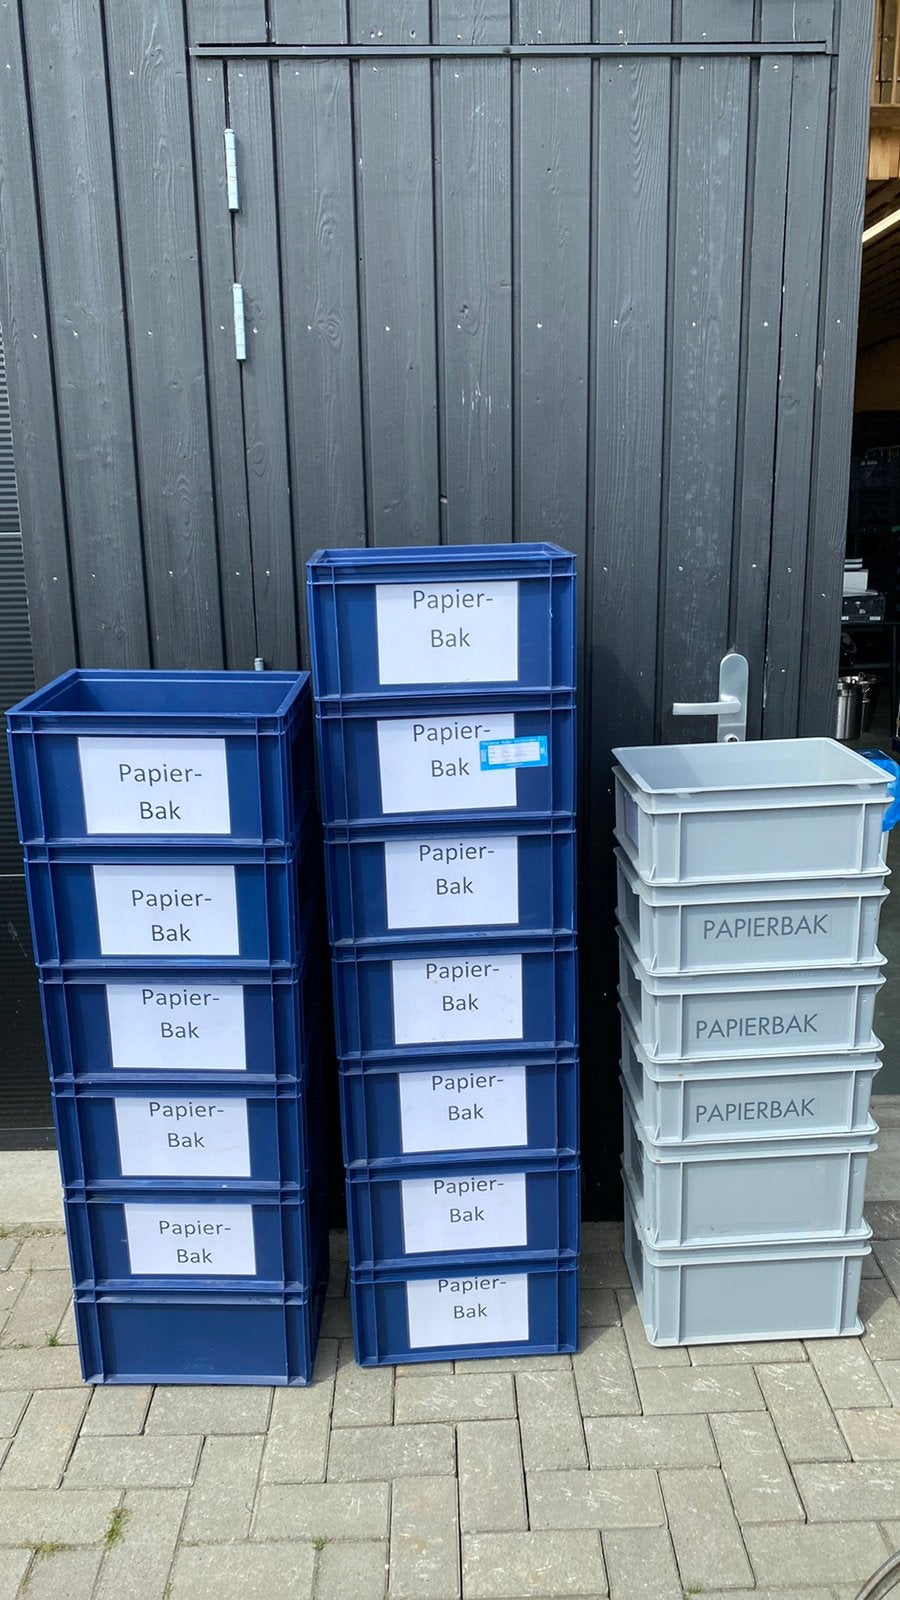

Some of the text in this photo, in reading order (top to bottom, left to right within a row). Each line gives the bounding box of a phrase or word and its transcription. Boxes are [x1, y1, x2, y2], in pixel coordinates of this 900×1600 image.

[413, 588, 494, 613] Papier-
[431, 627, 471, 648] Bak
[412, 721, 491, 745] Papier-
[119, 763, 203, 787] Papier-
[431, 757, 470, 778] Bak
[139, 800, 181, 820] Bak
[418, 842, 495, 865] Papier-
[436, 876, 474, 895] Bak
[131, 889, 212, 911] Papier-
[151, 923, 192, 942] Bak
[703, 914, 829, 940] PAPIERBAK
[426, 961, 500, 983] Papier-
[141, 988, 220, 1010] Papier-
[442, 993, 479, 1012] Bak
[160, 1021, 200, 1039] Bak
[696, 1013, 818, 1040] PAPIERBAK
[431, 1073, 504, 1093] Papier-
[149, 1101, 224, 1121] Papier-
[448, 1103, 484, 1121] Bak
[696, 1097, 815, 1124] PAPIERBAK
[167, 1131, 205, 1148] Bak
[433, 1177, 504, 1197] Papier-
[449, 1205, 485, 1223] Bak
[159, 1220, 231, 1239] Papier-
[176, 1248, 213, 1264] Bak
[437, 1276, 507, 1295] Papier-
[453, 1303, 488, 1319] Bak
